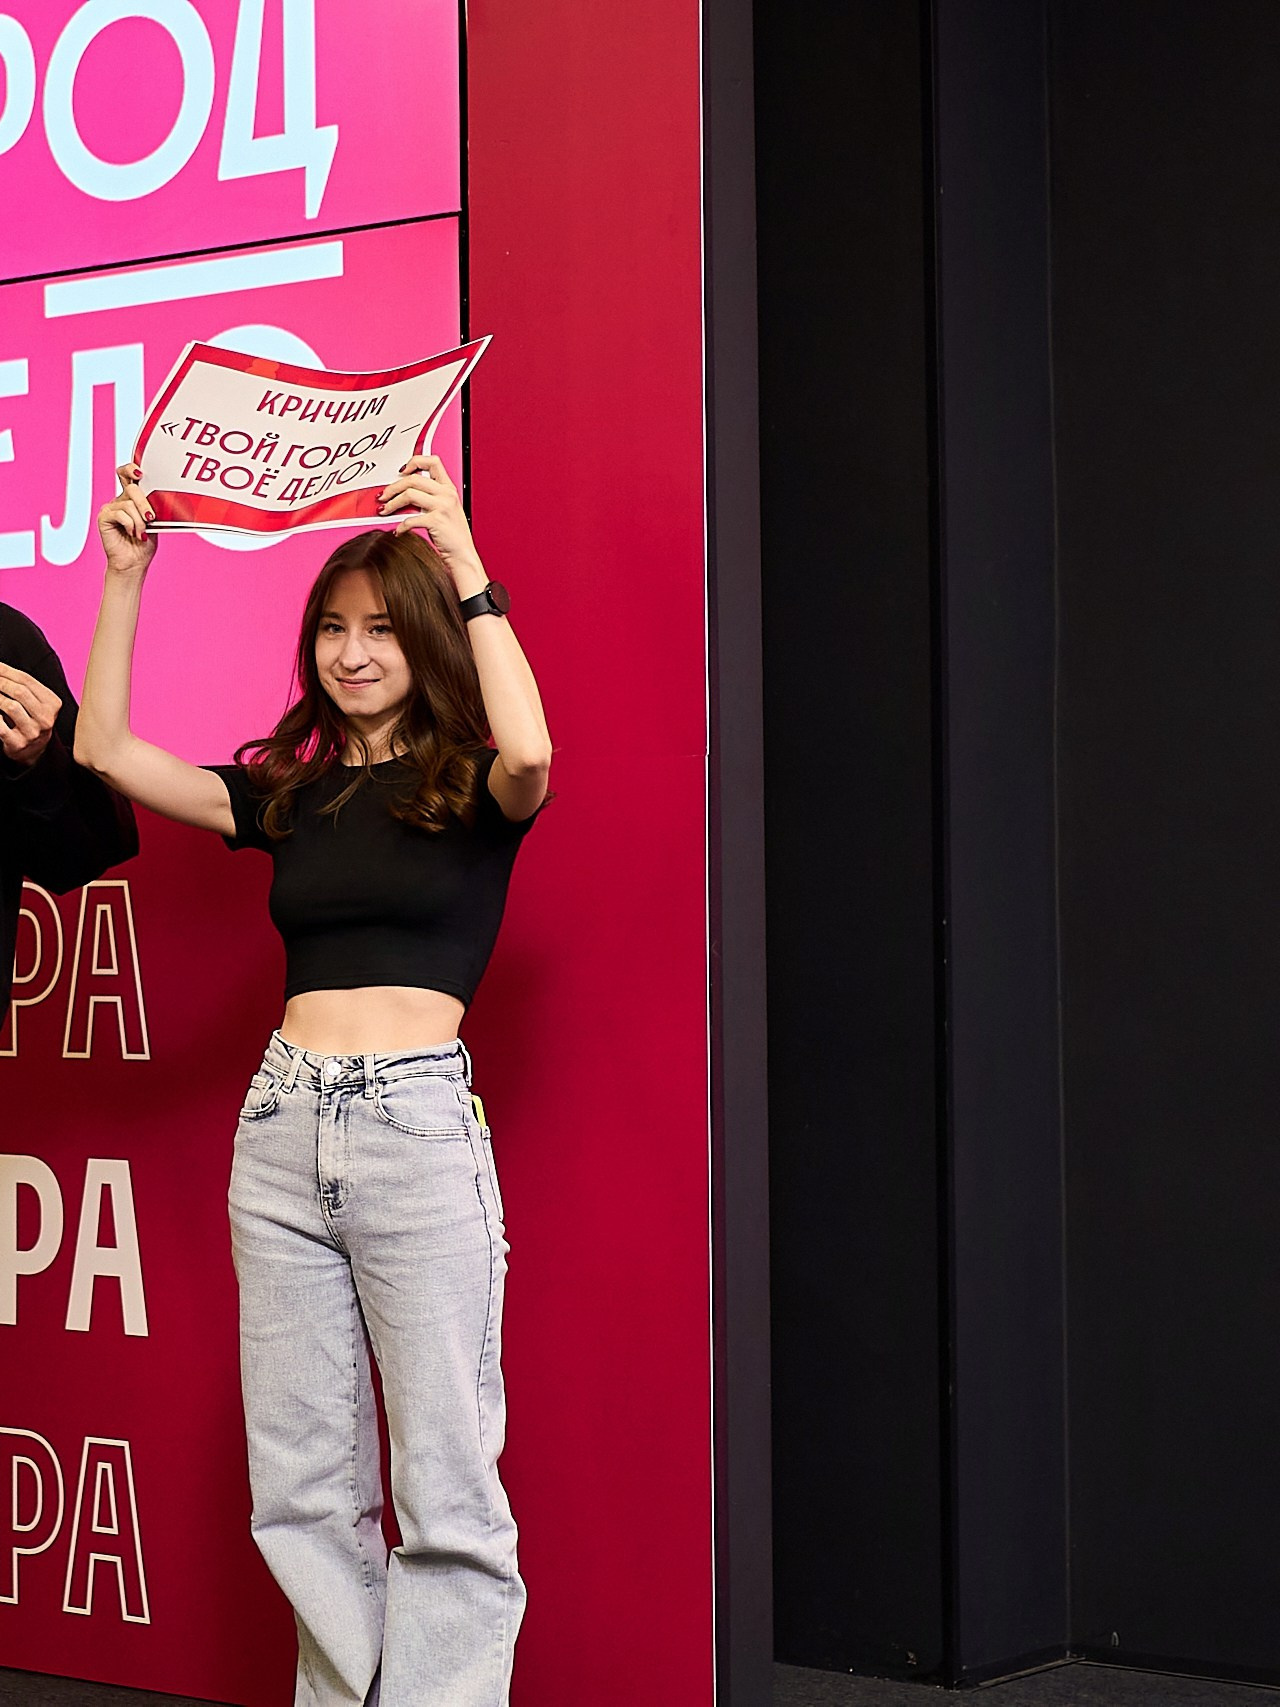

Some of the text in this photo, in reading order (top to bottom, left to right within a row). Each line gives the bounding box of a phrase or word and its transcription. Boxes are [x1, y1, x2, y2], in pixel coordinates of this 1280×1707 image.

[256, 389, 390, 424] КРИЧИМ
[159, 416, 282, 464] «ТВОЙ
[280, 424, 397, 470] ГОРОД
[179, 451, 377, 507] ТВОЁ ДЕЛО»
